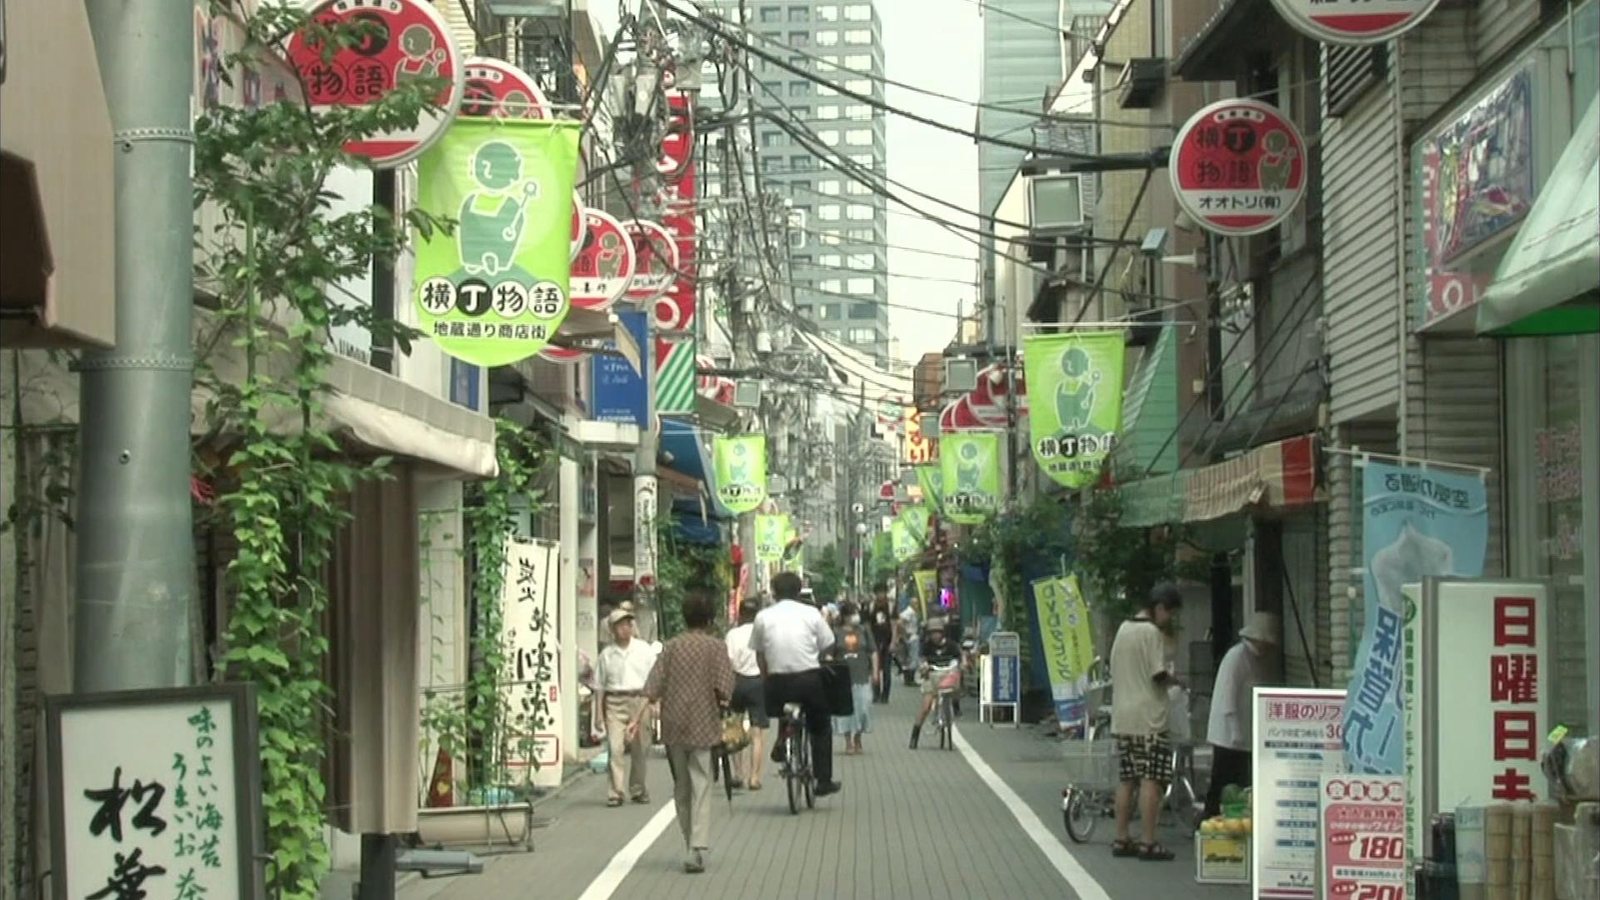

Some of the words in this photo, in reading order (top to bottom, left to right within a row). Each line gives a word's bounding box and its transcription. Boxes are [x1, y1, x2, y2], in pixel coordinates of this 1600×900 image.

[1199, 195, 1281, 210] オオトリ(有)
[421, 279, 563, 317] 横丁物語
[433, 321, 547, 340] 地蔵通り商店街
[187, 706, 223, 868] 味のよい海苔
[172, 752, 208, 900] うまいお茶
[1360, 836, 1403, 859] 180
[1358, 884, 1403, 900] 20
